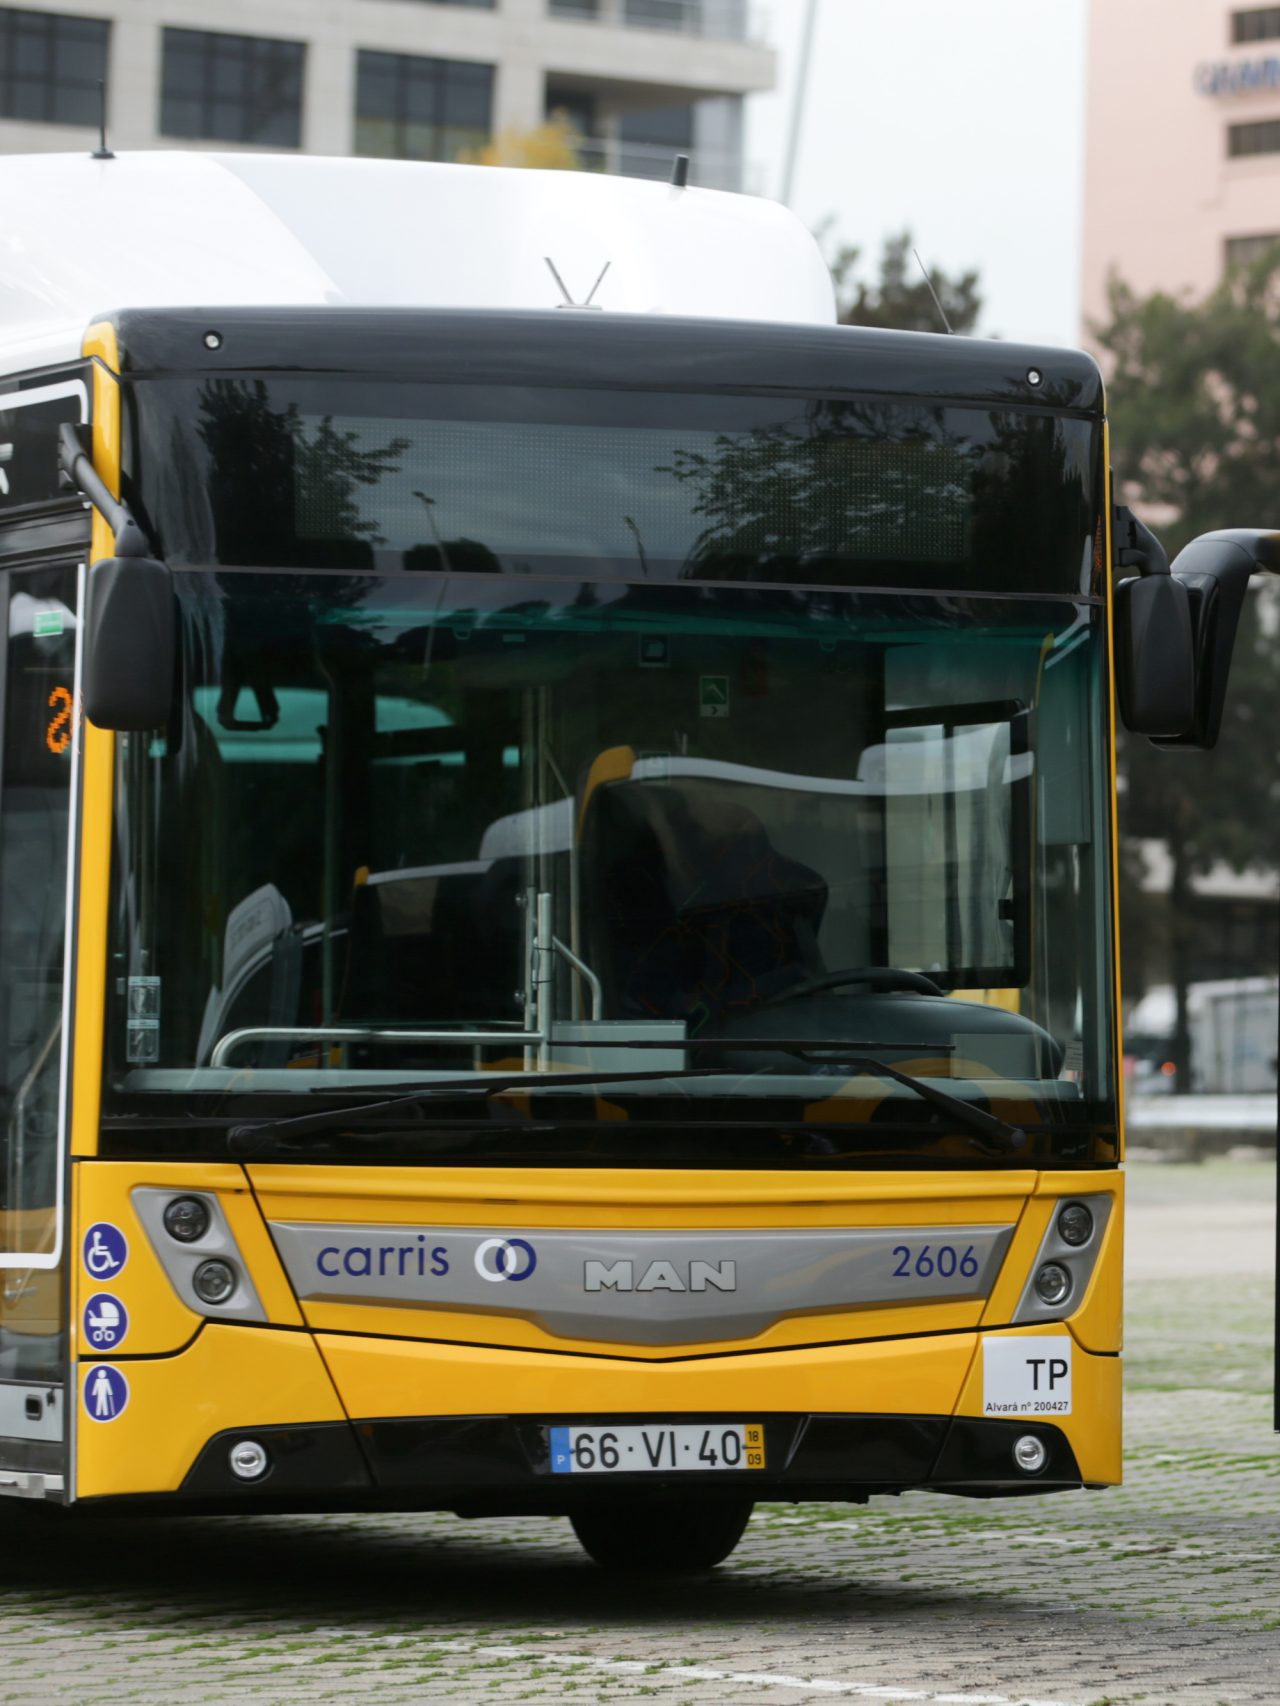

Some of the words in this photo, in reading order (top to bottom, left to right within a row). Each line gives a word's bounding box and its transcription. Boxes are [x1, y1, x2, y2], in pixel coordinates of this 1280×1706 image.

[316, 1234, 449, 1277] carris
[891, 1245, 979, 1277] 2606
[583, 1260, 737, 1292] MAN
[1026, 1358, 1068, 1391] TP
[985, 1402, 1018, 1412] Alvará
[1034, 1401, 1069, 1411] 200427
[748, 1430, 759, 1442] 18
[556, 1455, 566, 1465] P
[747, 1454, 762, 1465] 09
